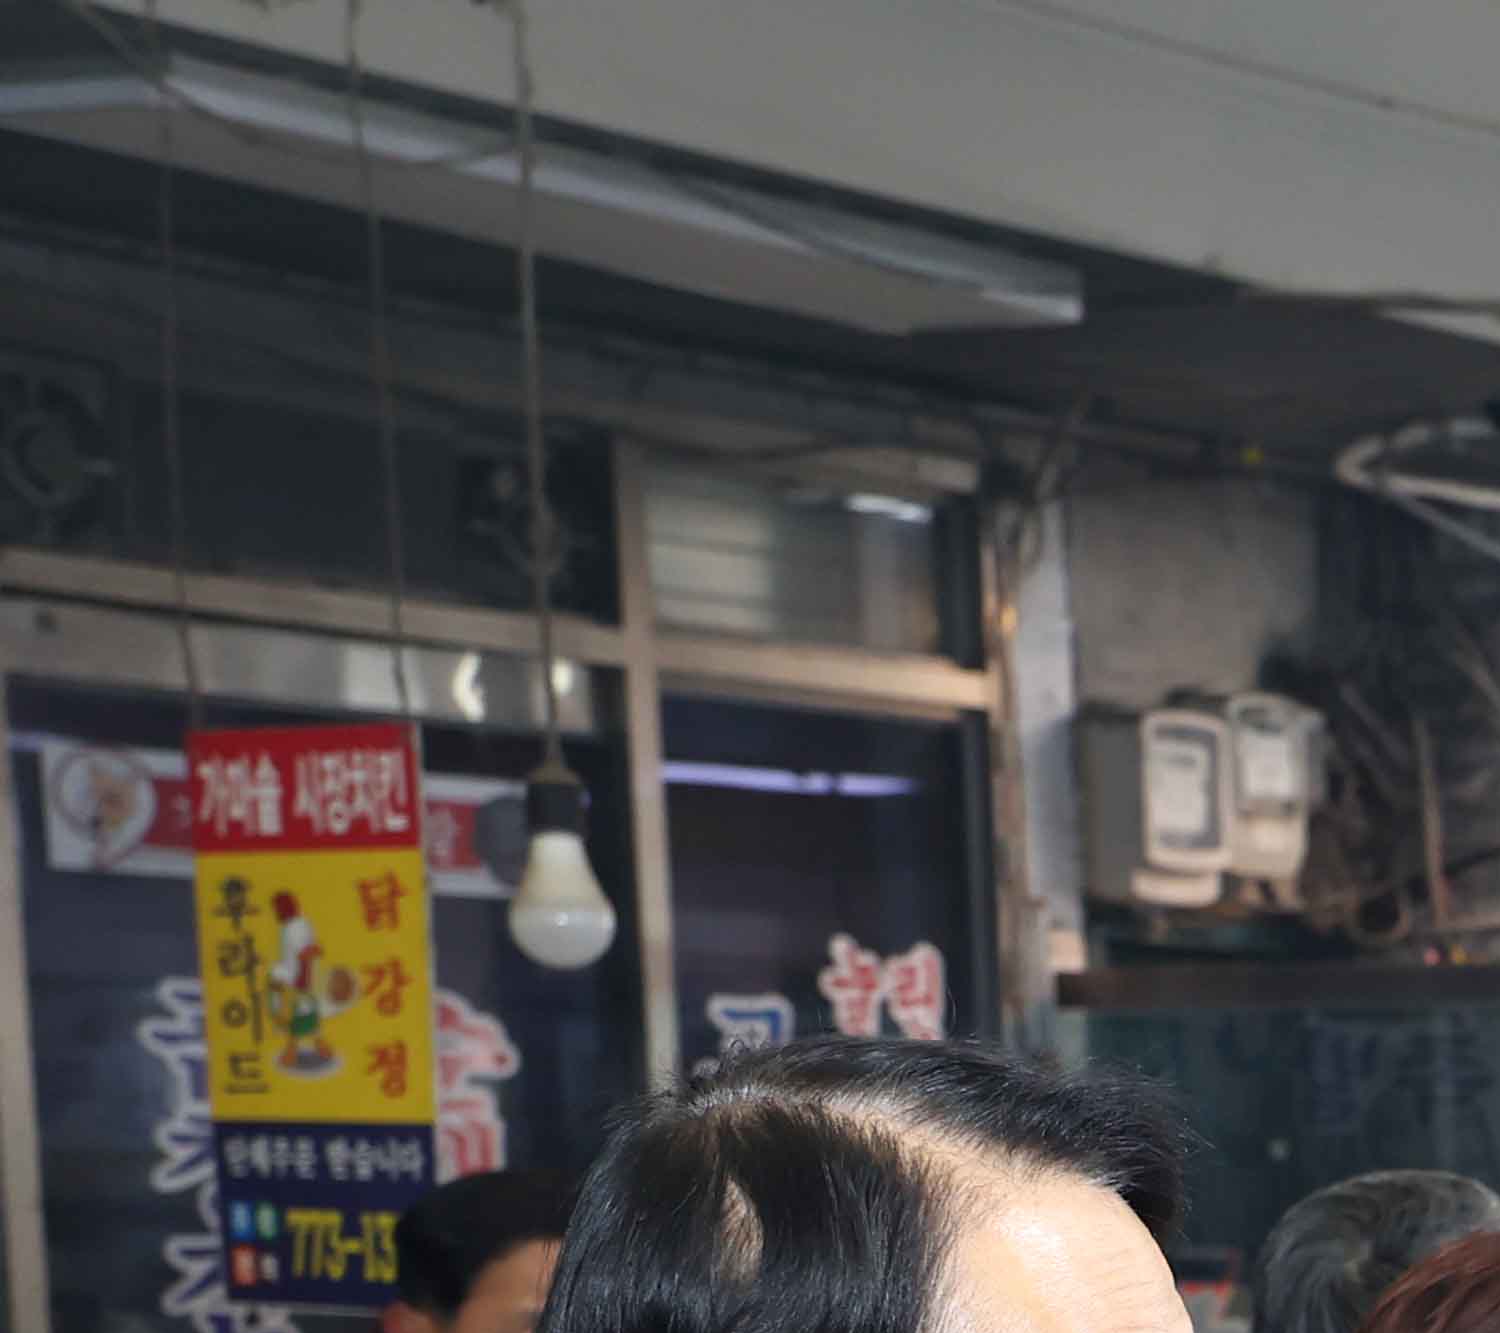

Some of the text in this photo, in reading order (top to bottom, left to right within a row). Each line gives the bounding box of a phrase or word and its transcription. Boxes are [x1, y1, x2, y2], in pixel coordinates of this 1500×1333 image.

[199, 751, 284, 838] 가마솥
[293, 745, 412, 836] 시장치킨
[212, 876, 272, 1096] 후라이드
[356, 872, 416, 1100] 닭강정
[324, 1134, 424, 1182] 받습니다
